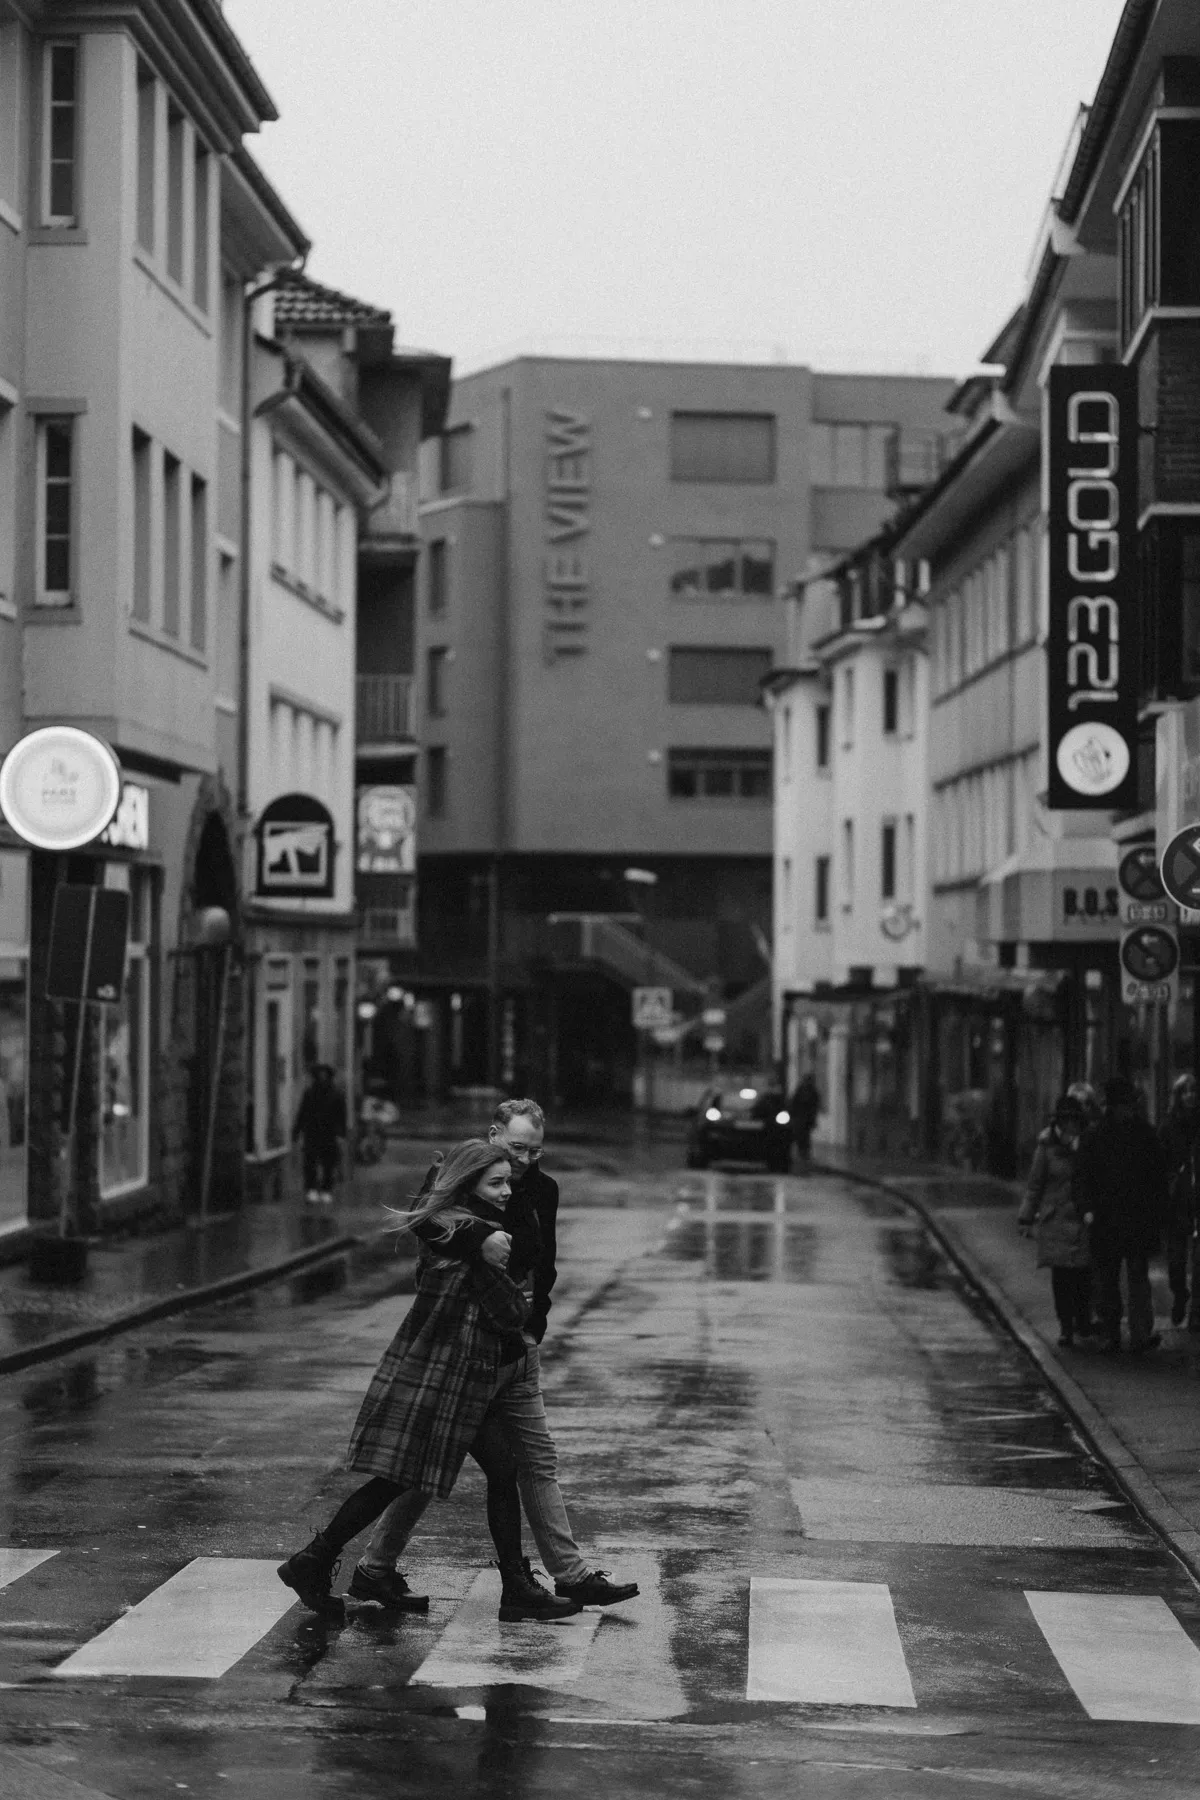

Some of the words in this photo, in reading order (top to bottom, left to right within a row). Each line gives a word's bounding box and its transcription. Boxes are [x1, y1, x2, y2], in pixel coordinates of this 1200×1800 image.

[543, 410, 589, 545] VIEW
[1067, 391, 1119, 583] GOLD
[543, 556, 588, 667] THE
[1067, 595, 1119, 710] 123
